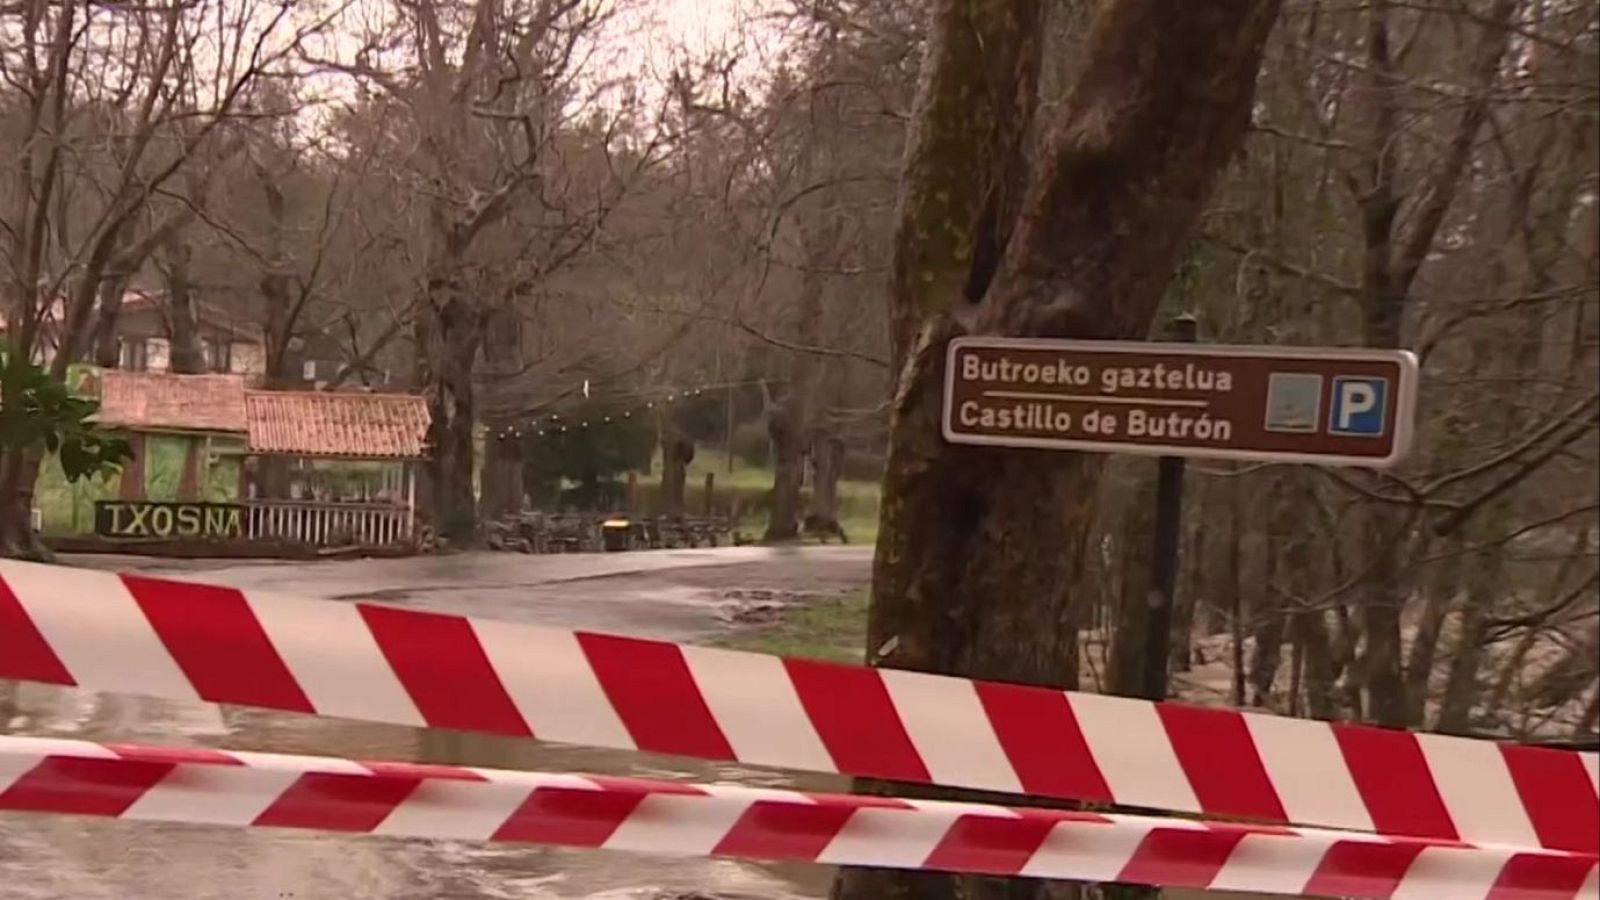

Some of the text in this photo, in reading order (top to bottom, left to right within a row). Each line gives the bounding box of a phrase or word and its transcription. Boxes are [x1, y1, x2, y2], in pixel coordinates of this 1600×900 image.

[963, 354, 1233, 393] Butroeko gaztelua
[959, 401, 1232, 441] Castillo de Butrón
[1339, 381, 1375, 429] P
[104, 503, 242, 537] TXOSNA
